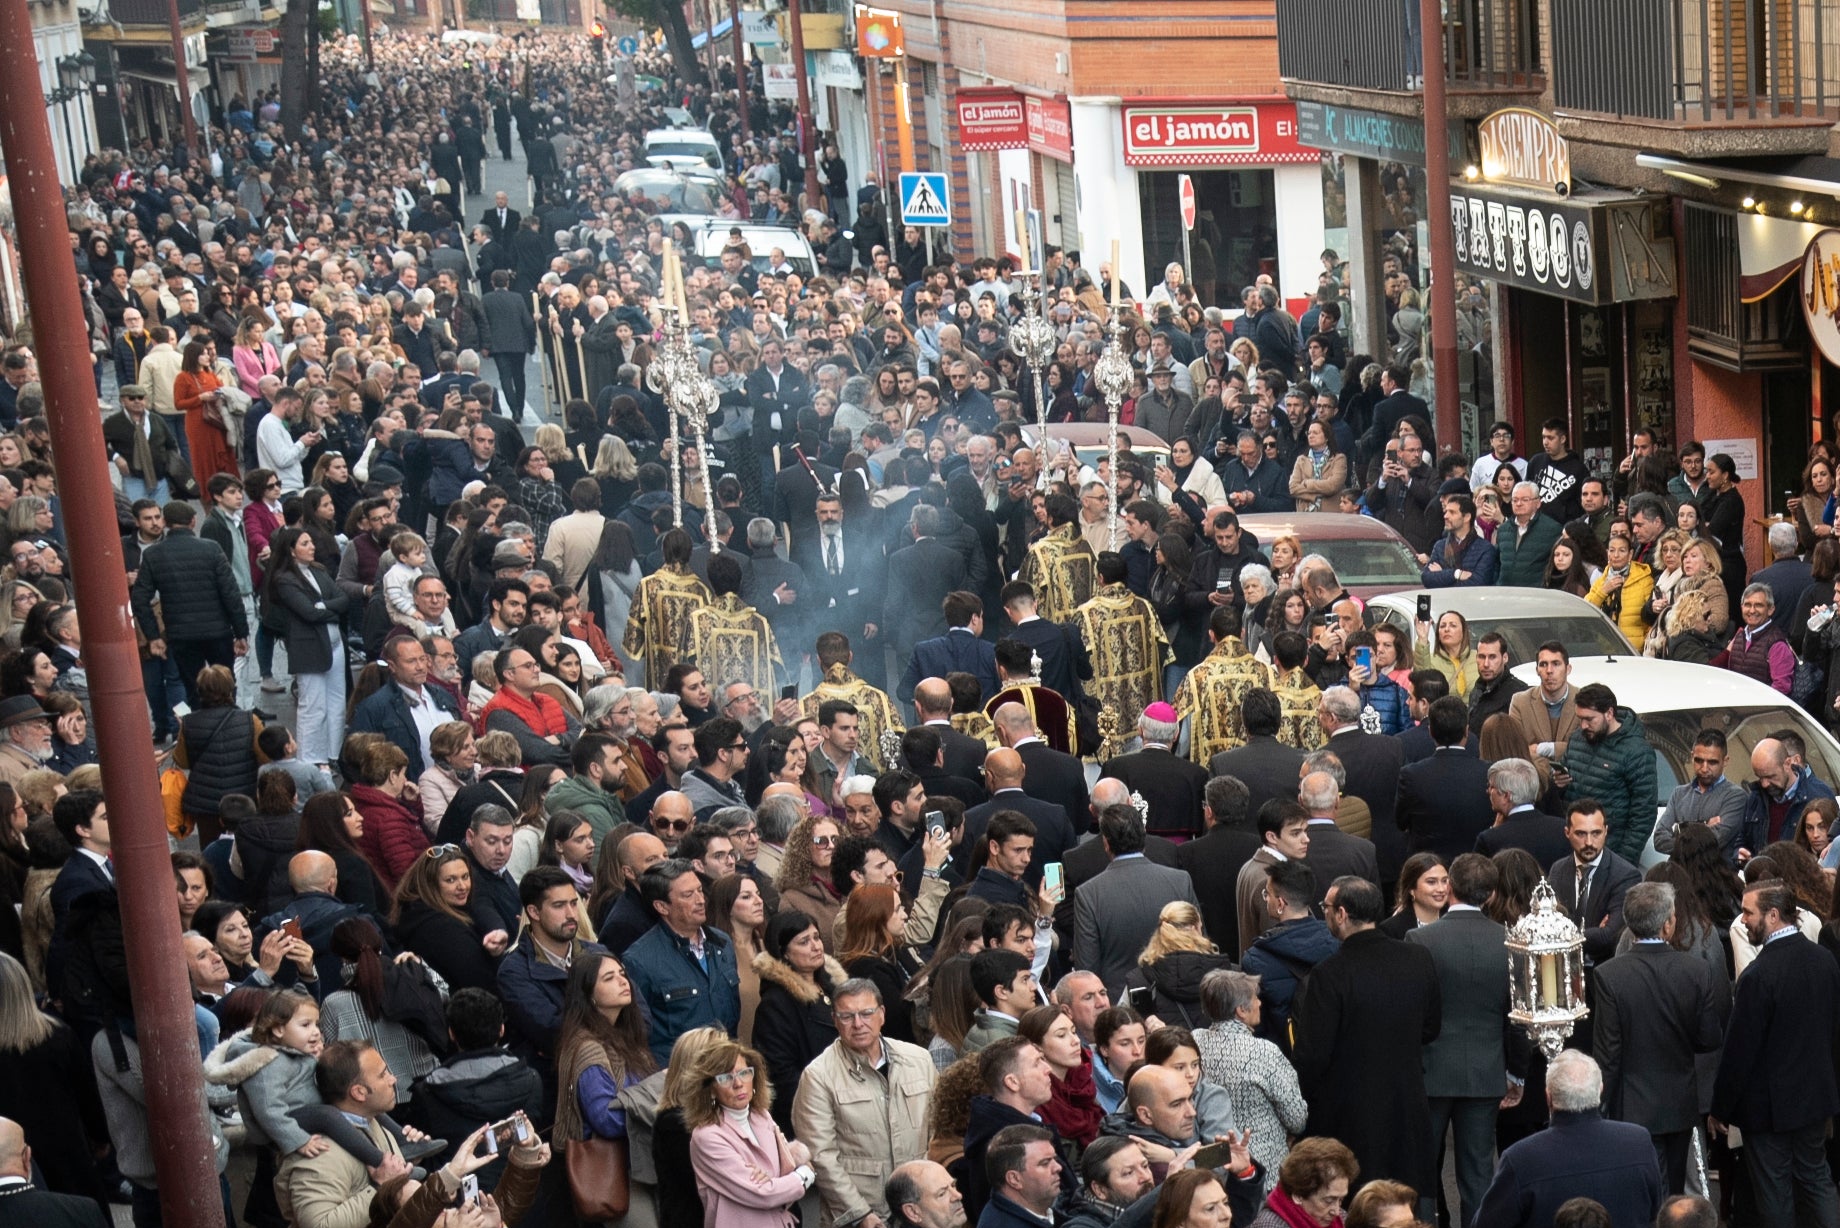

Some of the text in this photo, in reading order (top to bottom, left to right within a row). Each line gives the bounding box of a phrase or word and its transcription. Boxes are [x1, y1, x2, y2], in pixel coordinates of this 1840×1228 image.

[965, 106, 976, 119] el
[979, 104, 1018, 120] jamón
[1276, 121, 1291, 136] El
[1136, 113, 1250, 146] el jamón
[1344, 114, 1393, 148] ALMACENES
[1450, 195, 1571, 288] TATTOO
